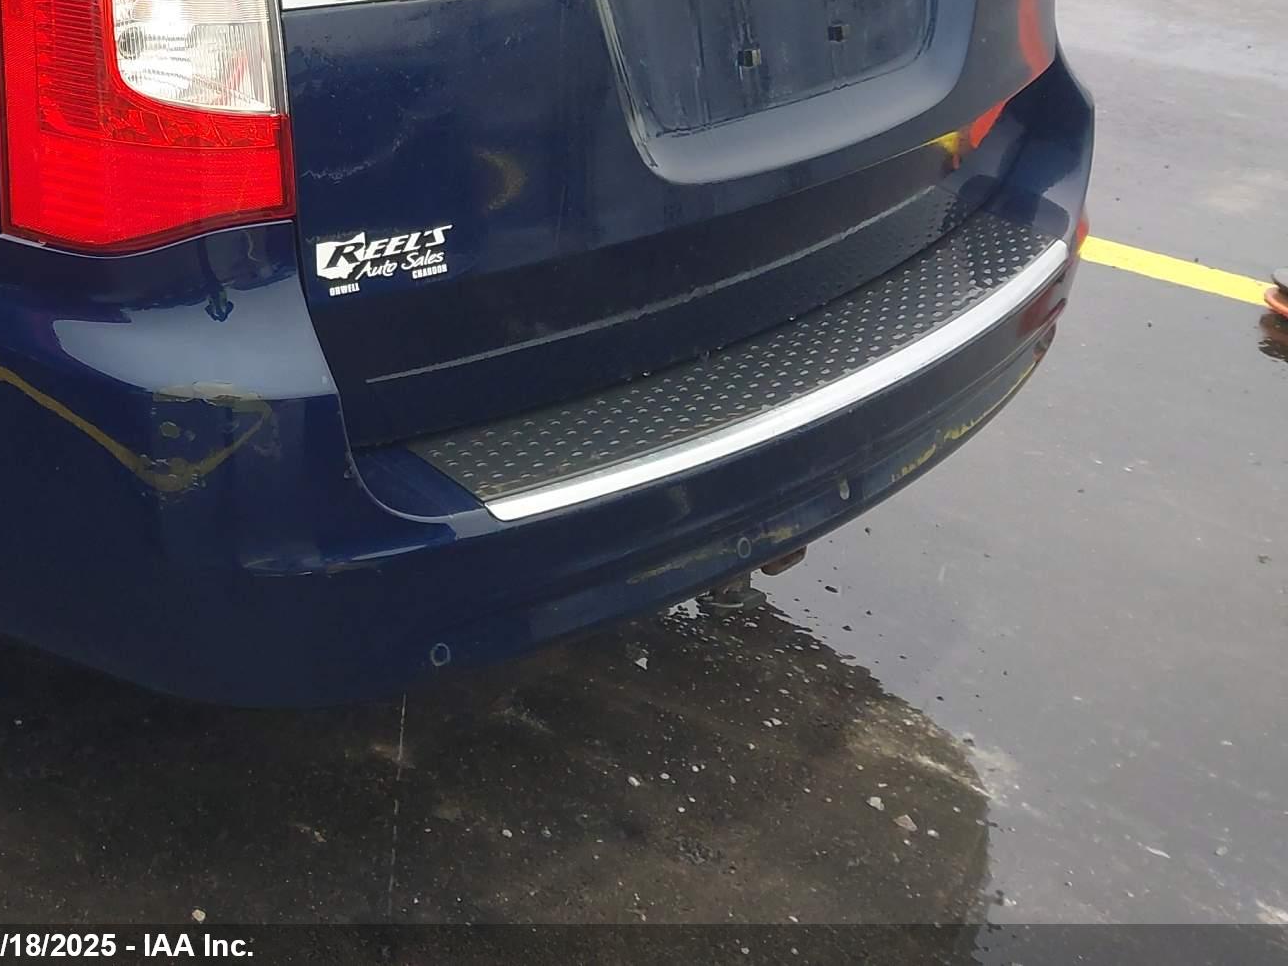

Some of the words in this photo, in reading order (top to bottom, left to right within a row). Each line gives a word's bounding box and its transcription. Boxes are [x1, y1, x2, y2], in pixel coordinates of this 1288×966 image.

[323, 225, 453, 270] REEL'S
[355, 260, 397, 281] Auto
[401, 250, 444, 270] Sales
[329, 283, 360, 296] ORWELL
